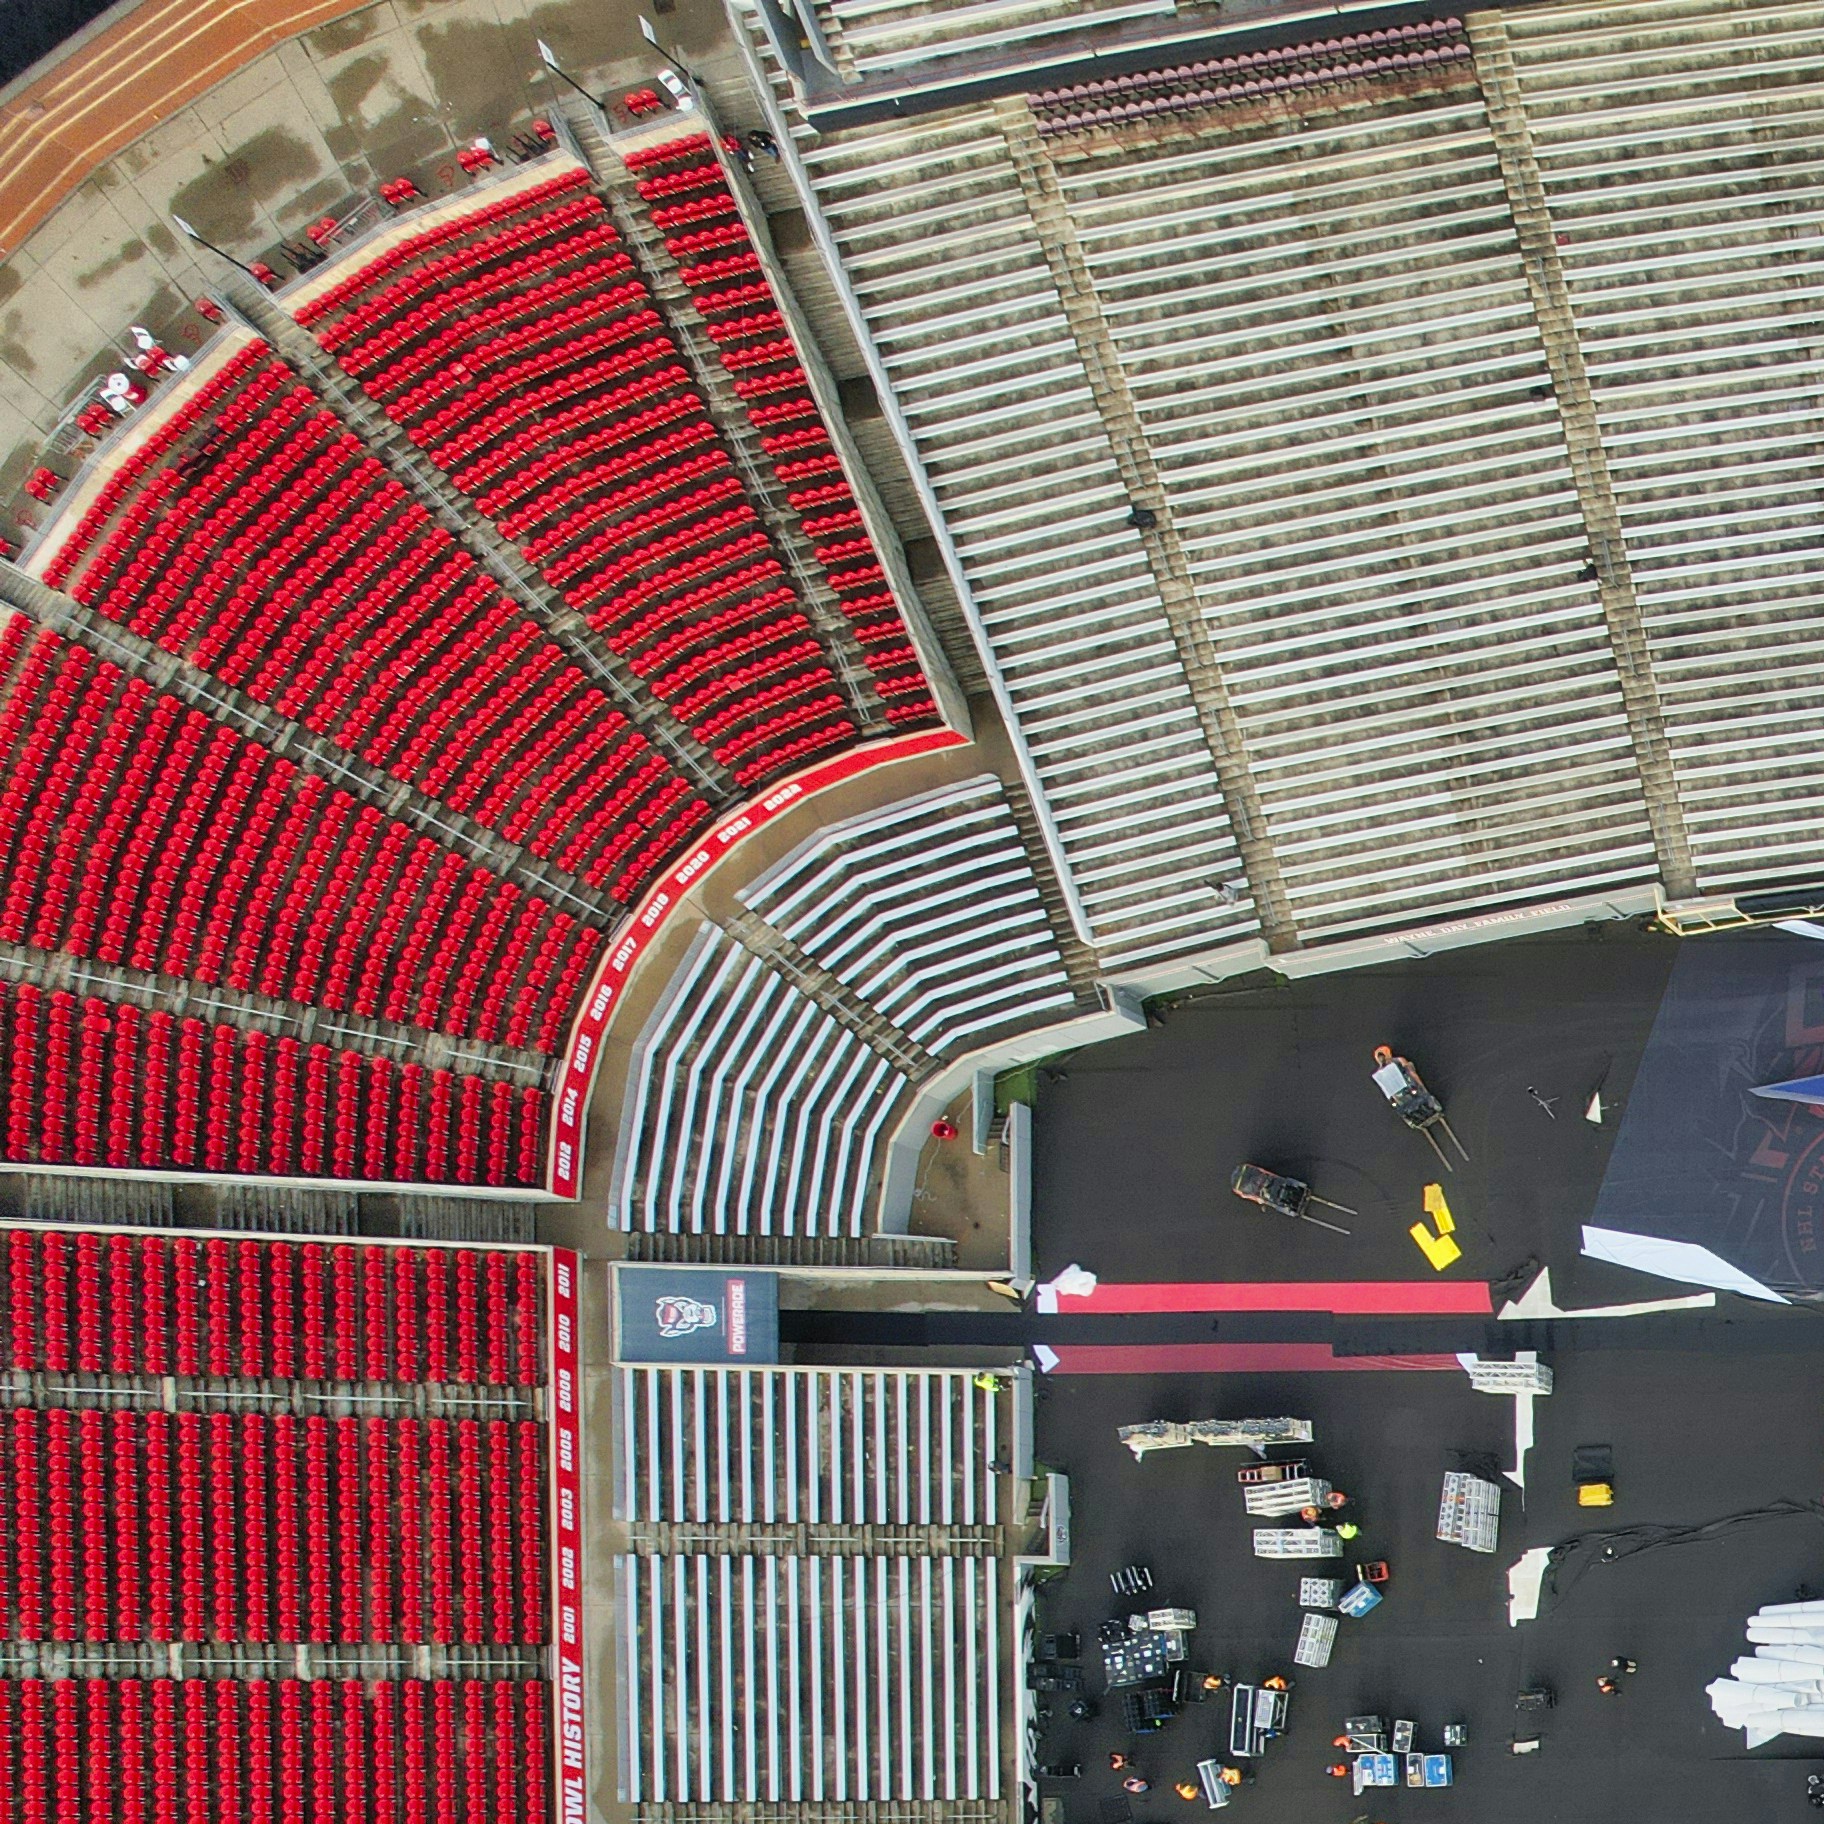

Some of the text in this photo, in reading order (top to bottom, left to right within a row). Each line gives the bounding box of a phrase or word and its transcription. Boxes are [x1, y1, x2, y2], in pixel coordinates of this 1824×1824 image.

[716, 816, 752, 844] 2021
[674, 850, 711, 885] 2020
[611, 936, 637, 972] 2017
[589, 984, 613, 1022] 2016
[573, 1033, 592, 1073] 2015
[561, 1087, 579, 1127] 2014
[557, 1141, 572, 1181] 2012
[557, 1263, 570, 1299] 2011
[557, 1313, 571, 1353] 2010
[731, 1283, 745, 1353] POWERADE
[559, 1427, 573, 1472] 2005
[560, 1487, 574, 1531] 2003
[561, 1546, 575, 1590] 2002
[562, 1605, 576, 1645] 2001
[561, 1656, 584, 1767] HISTORY
